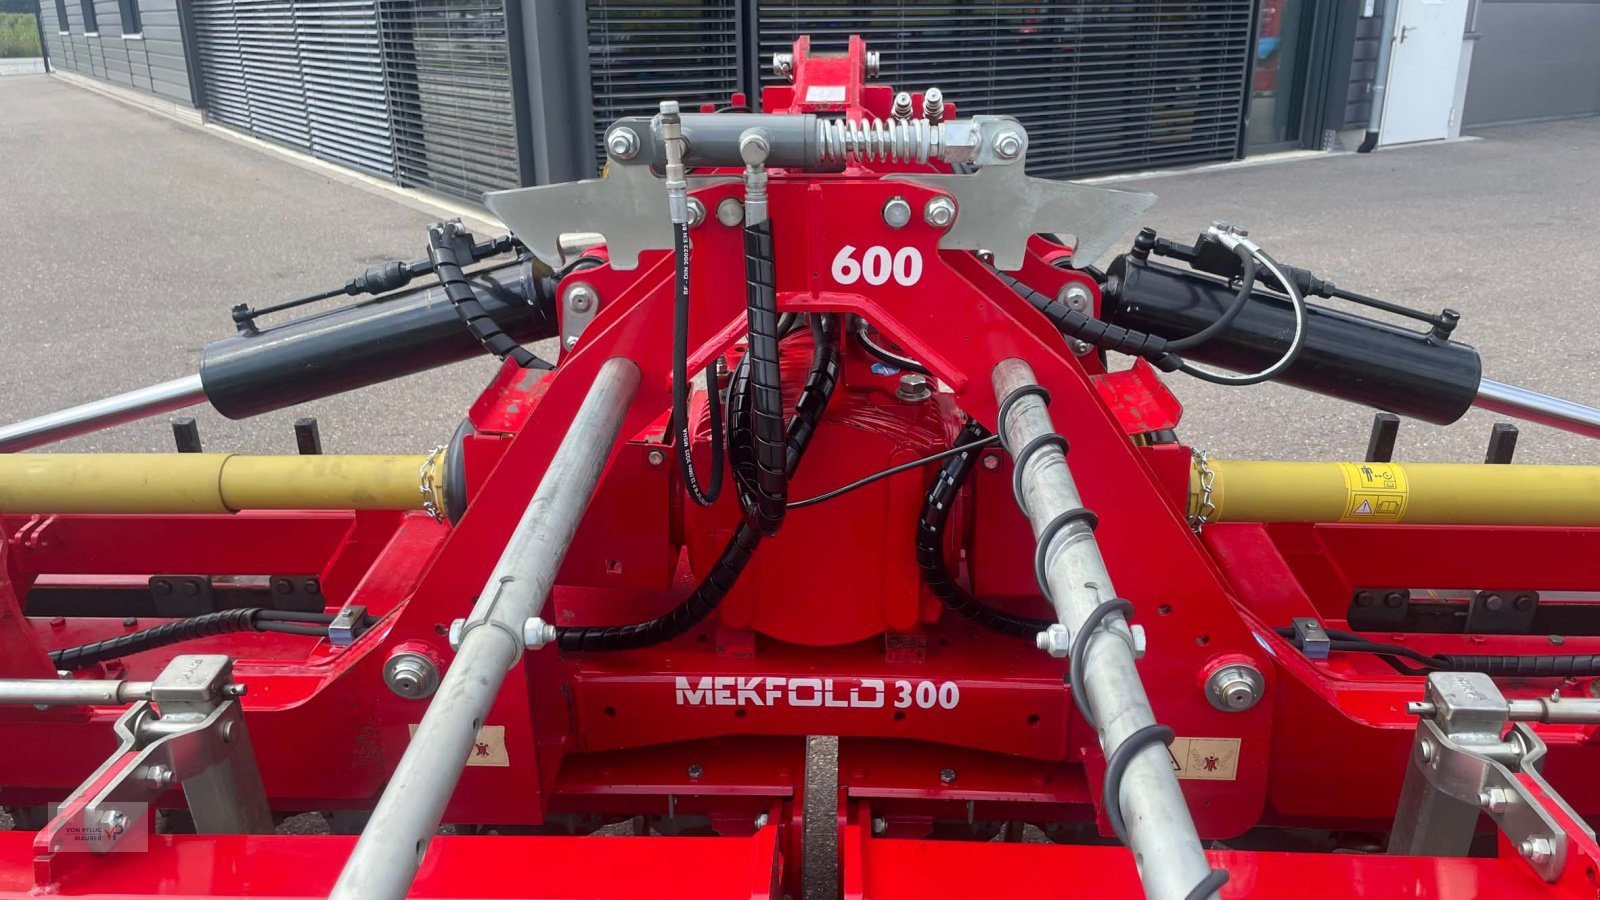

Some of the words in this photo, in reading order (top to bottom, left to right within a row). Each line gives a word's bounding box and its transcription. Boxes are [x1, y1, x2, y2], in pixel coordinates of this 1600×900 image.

[682, 232, 688, 243] EN
[831, 244, 923, 287] 600
[675, 676, 885, 708] MEKFOLD
[893, 680, 960, 709] 300
